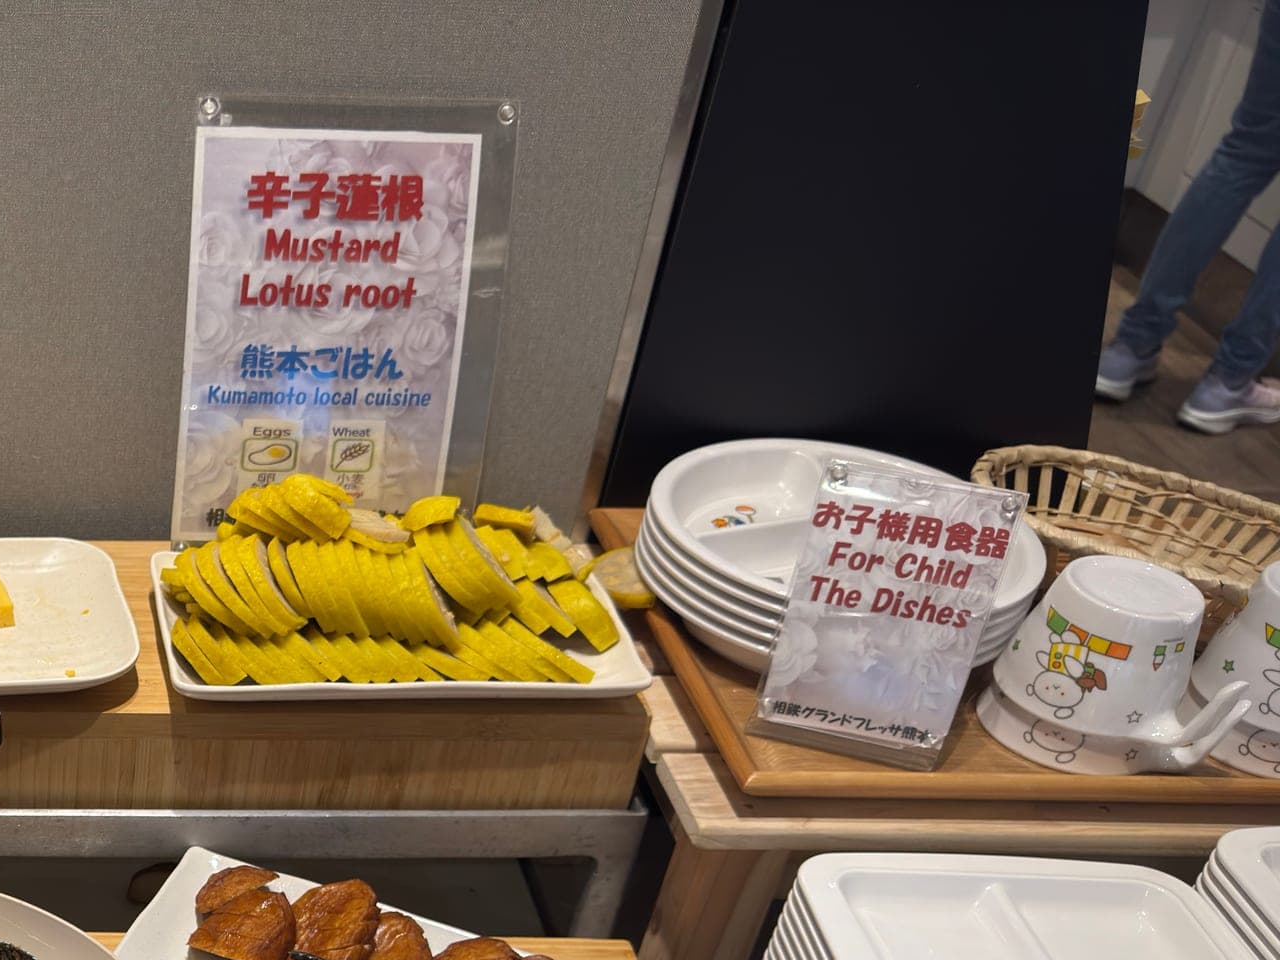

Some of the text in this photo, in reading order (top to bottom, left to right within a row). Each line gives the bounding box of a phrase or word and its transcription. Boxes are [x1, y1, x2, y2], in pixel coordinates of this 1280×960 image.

[247, 171, 424, 222] 辛子蓮根
[263, 228, 401, 264] Mustard
[240, 273, 417, 309] Lotus root
[240, 343, 404, 380] 熊本ごはん
[207, 385, 432, 407] Kumamoto local cuisine
[253, 426, 291, 438] Eggs
[332, 427, 370, 438] Wheat
[812, 501, 1010, 560] お子様用食器
[827, 541, 973, 590] For Child
[810, 575, 971, 628] The Dishes
